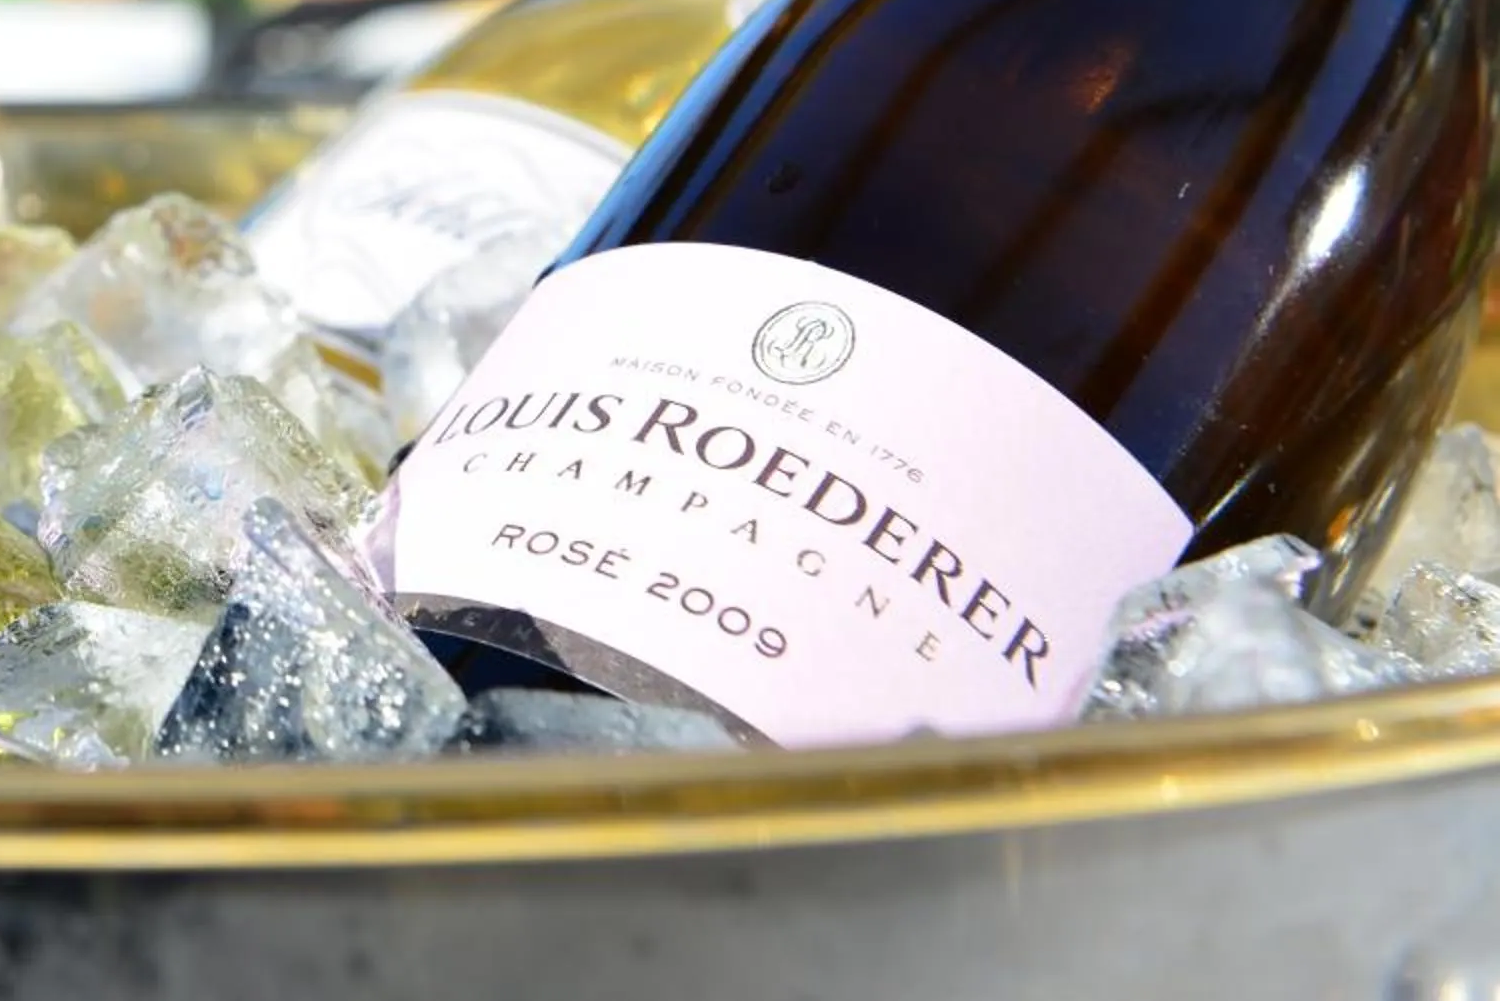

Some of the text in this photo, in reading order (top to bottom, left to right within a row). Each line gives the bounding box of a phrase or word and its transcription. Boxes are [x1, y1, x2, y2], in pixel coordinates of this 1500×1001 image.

[610, 356, 924, 484] MAISON FONDÉE EN 1776
[434, 392, 623, 445] LOUIS
[632, 398, 1050, 690] ROEDERER
[463, 452, 941, 662] CHAMPAGNE
[492, 524, 631, 580] ROSÉ
[646, 572, 787, 659] 2009
